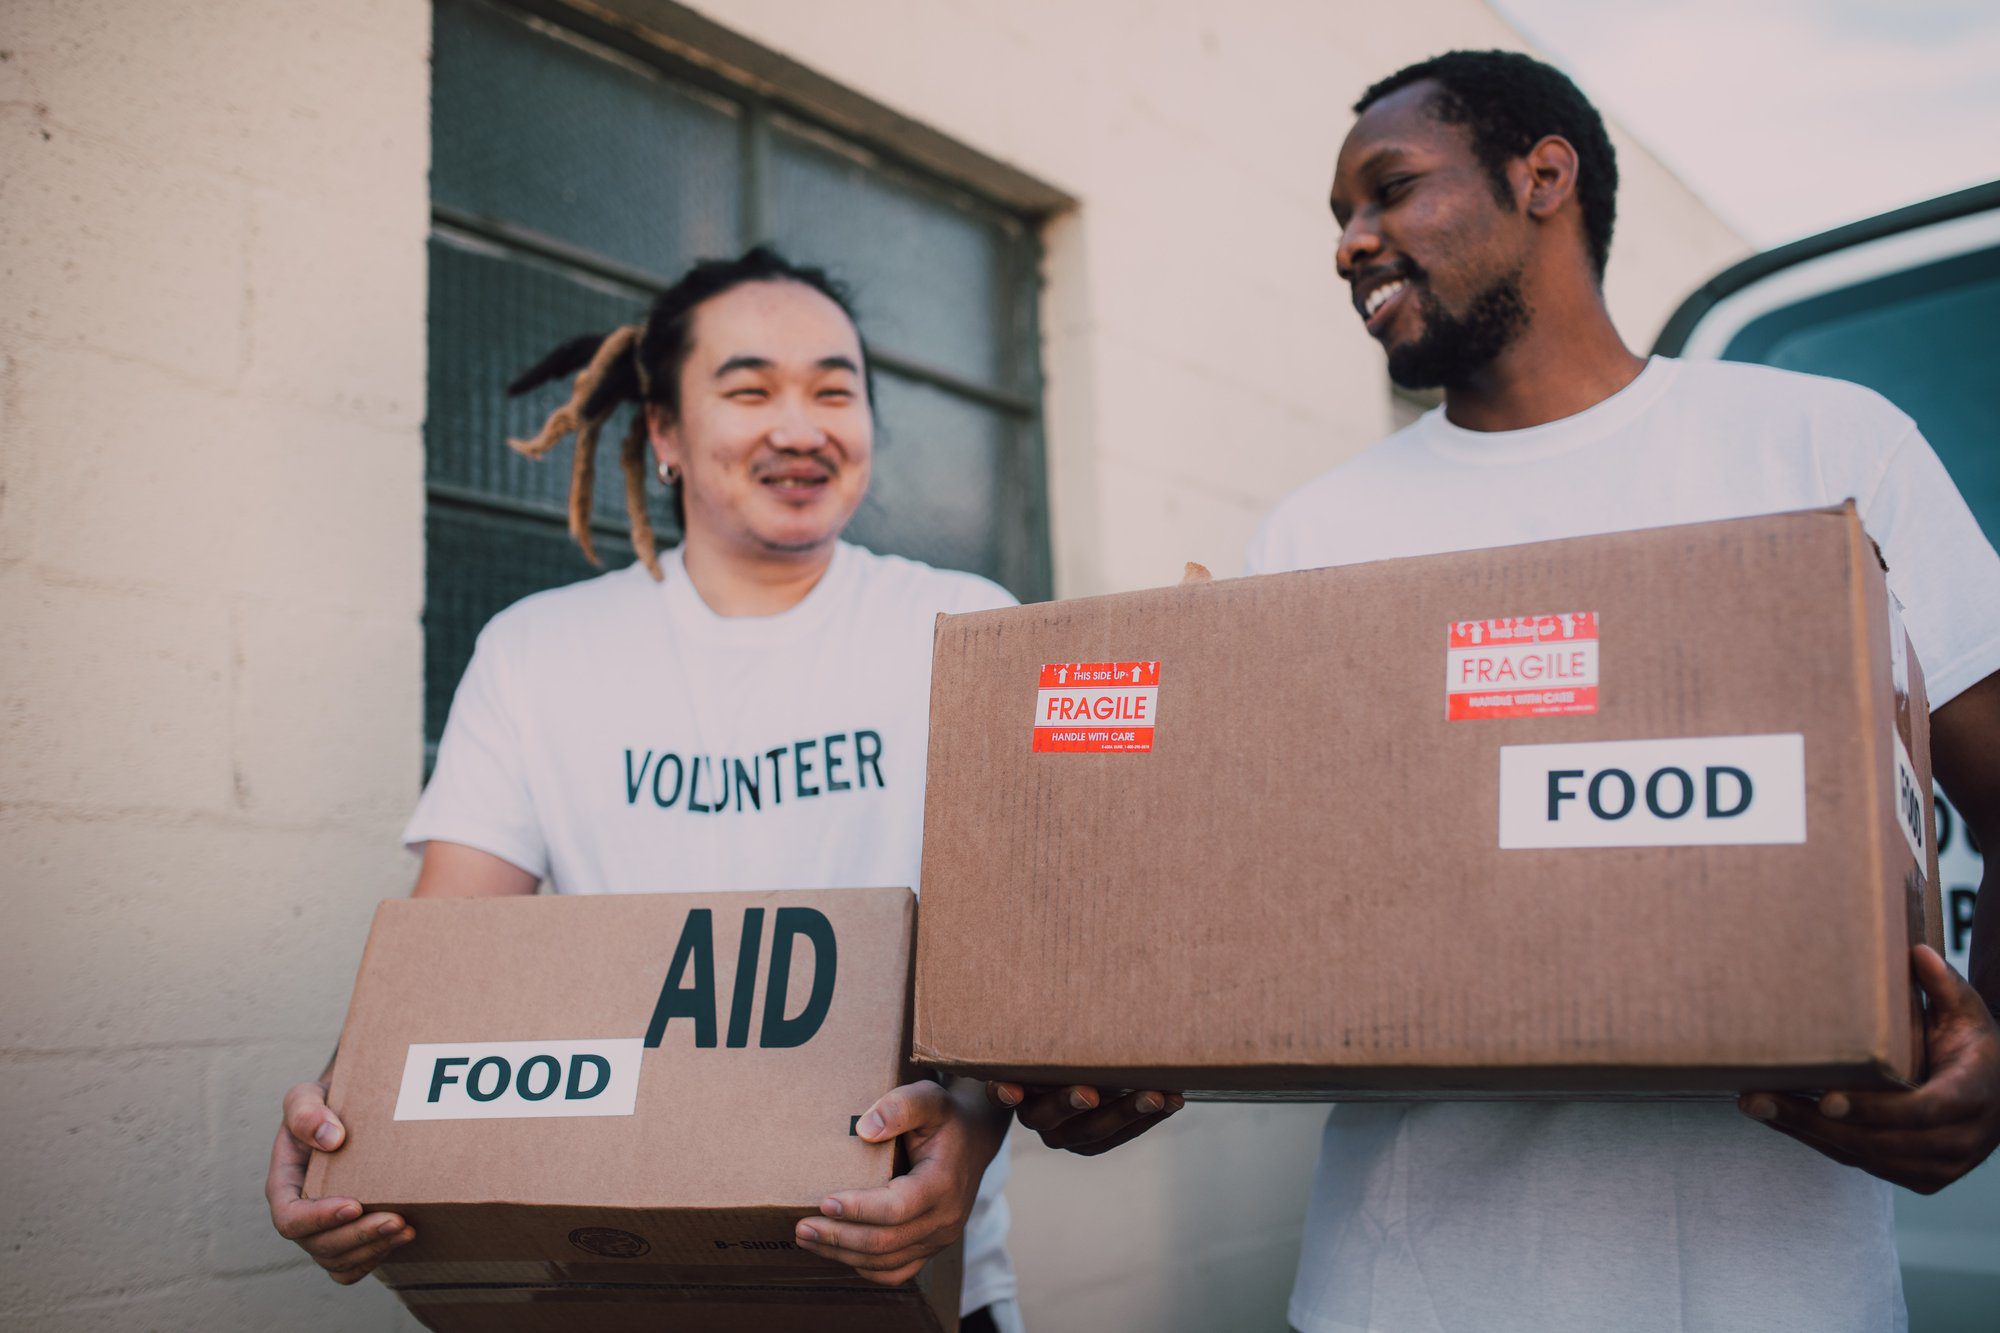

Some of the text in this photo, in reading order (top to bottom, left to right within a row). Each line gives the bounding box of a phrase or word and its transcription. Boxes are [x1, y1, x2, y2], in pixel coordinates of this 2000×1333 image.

[1073, 671, 1126, 681] THIS SIDE UP
[1461, 652, 1585, 683] FRAGILE
[1046, 696, 1147, 720] FRAGILE
[1052, 731, 1136, 742] HANDLE WITH CARE
[625, 730, 885, 812] VOLUNTEER
[1547, 766, 1754, 822] FOOD
[644, 907, 838, 1048] AID
[426, 1054, 612, 1103] FOOD
